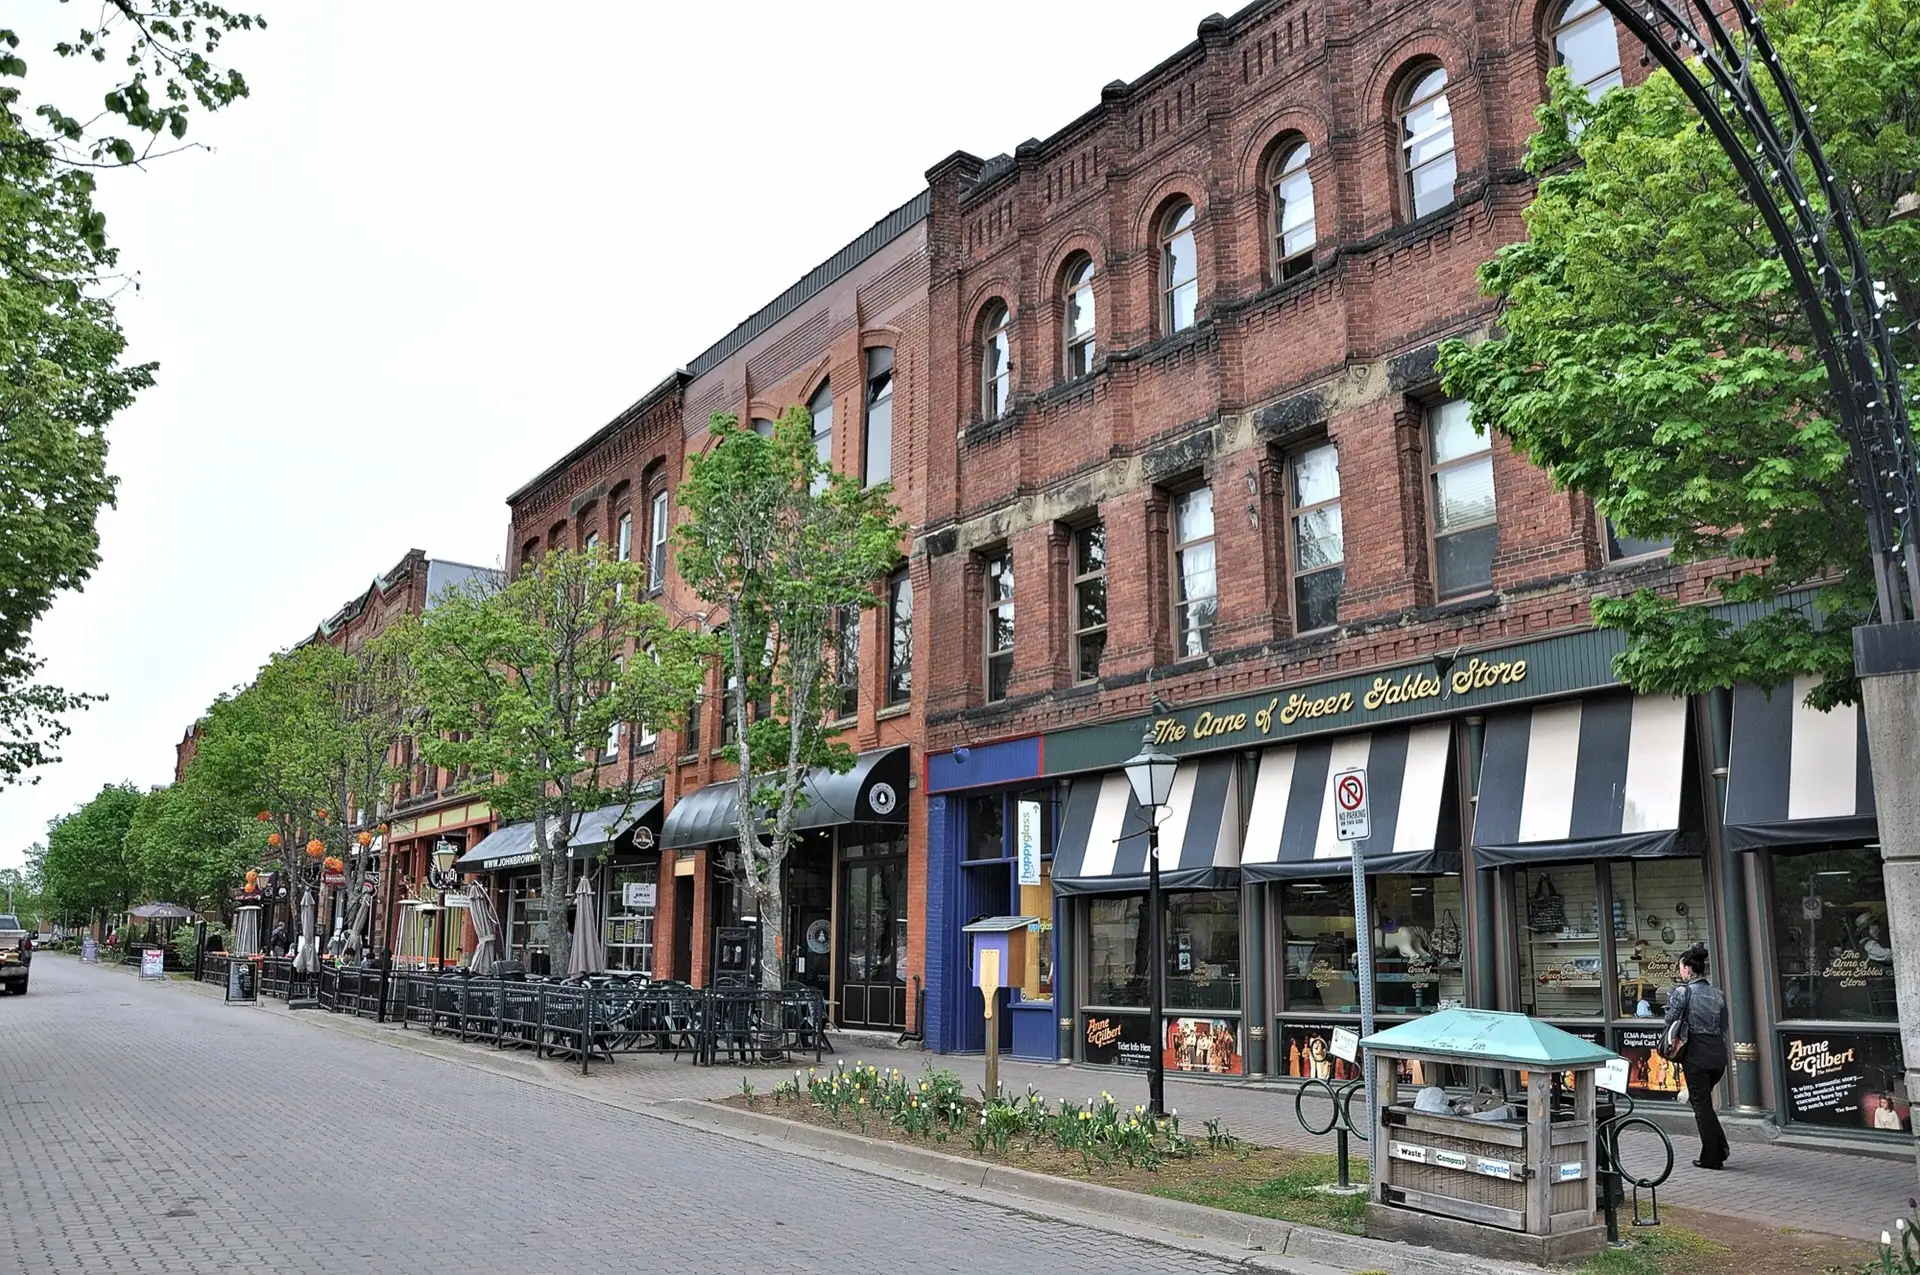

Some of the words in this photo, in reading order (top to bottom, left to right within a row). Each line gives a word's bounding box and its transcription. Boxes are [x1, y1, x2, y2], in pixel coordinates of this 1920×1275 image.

[1154, 717, 1187, 745] The
[1193, 711, 1248, 740] Anne
[1255, 698, 1279, 734] of
[1280, 690, 1355, 725] Green
[1363, 672, 1441, 710] Gables
[1452, 658, 1528, 694] Store
[1339, 812, 1346, 821] NO
[1346, 809, 1367, 820] PARKING
[1021, 812, 1032, 879] happyglass
[1841, 949, 1860, 960] The
[1833, 959, 1858, 968] Anne
[1860, 958, 1870, 969] of
[1823, 967, 1852, 978] Green
[1853, 967, 1883, 978] Gables
[1840, 978, 1867, 988] Store
[1086, 1018, 1110, 1034] Anne
[1117, 1041, 1130, 1051] Ticket
[1130, 1042, 1140, 1051] Info
[1623, 1039, 1643, 1047] Original
[1643, 1039, 1656, 1047] Cast
[1787, 1040, 1829, 1060] Anne
[1401, 1148, 1422, 1158] Waste
[1437, 1154, 1466, 1166] Compost
[1480, 1163, 1509, 1174] Recycle
